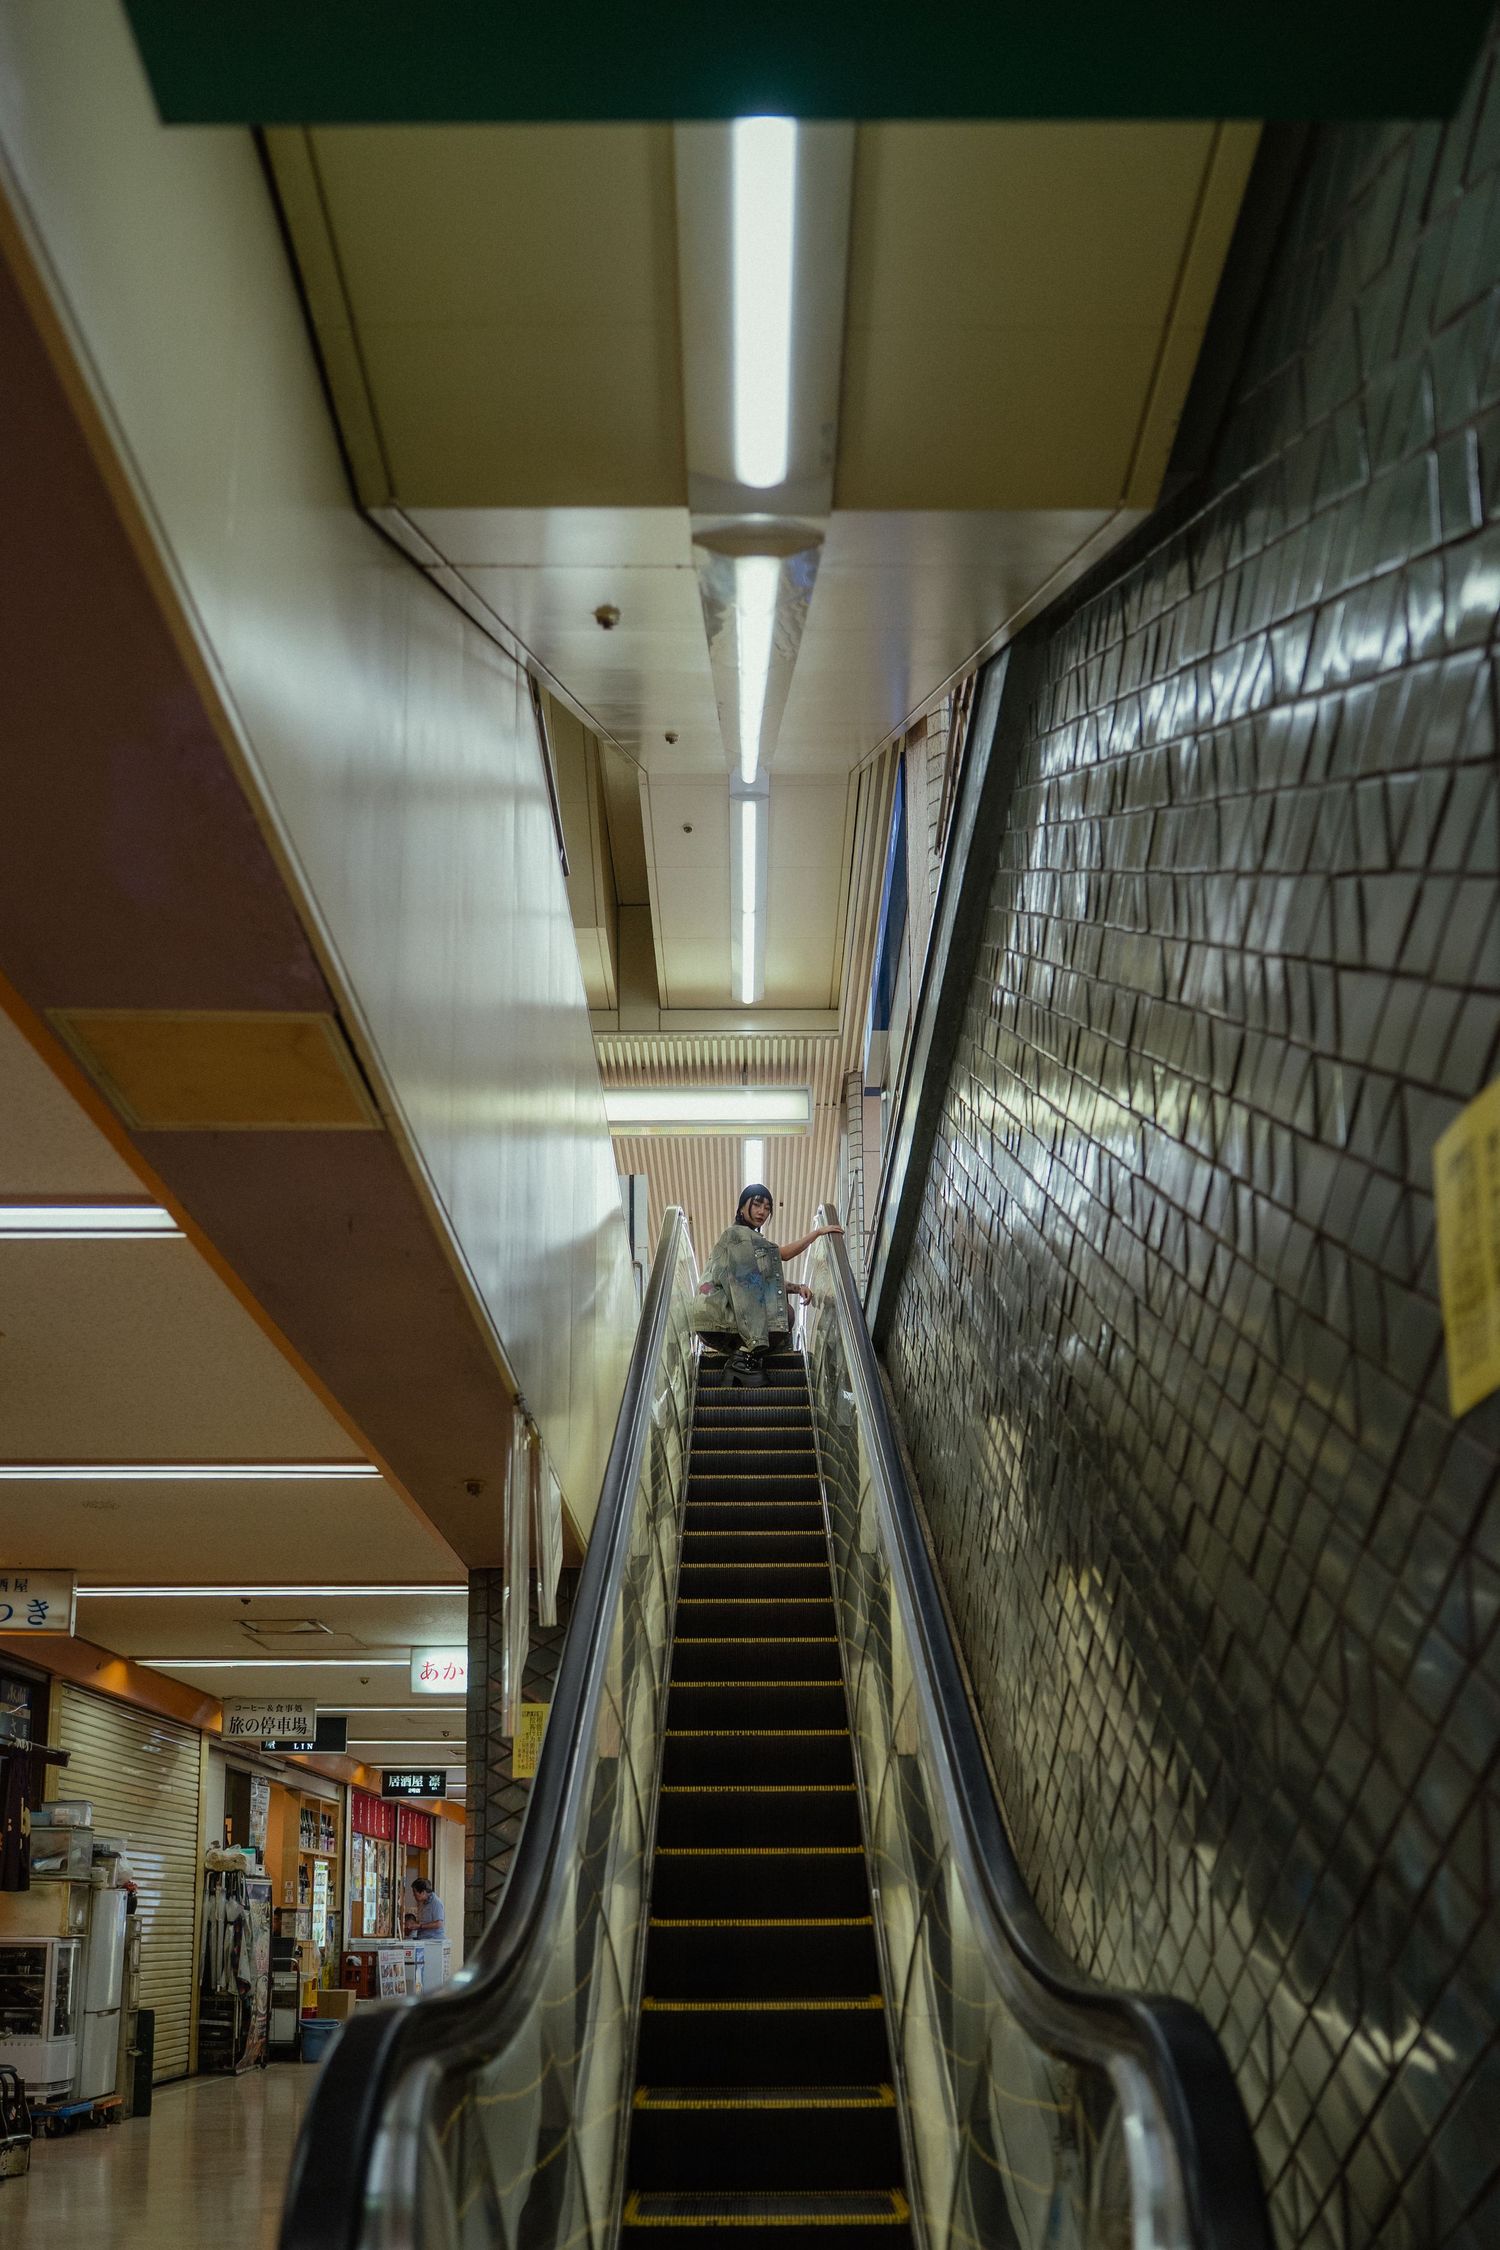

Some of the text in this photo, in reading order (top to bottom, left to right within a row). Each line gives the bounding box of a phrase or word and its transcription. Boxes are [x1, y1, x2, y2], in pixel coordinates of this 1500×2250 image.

[420, 1661, 464, 1681] あか
[229, 1716, 308, 1735] 旅の停車場
[388, 1775, 424, 1787] 居酒屋
